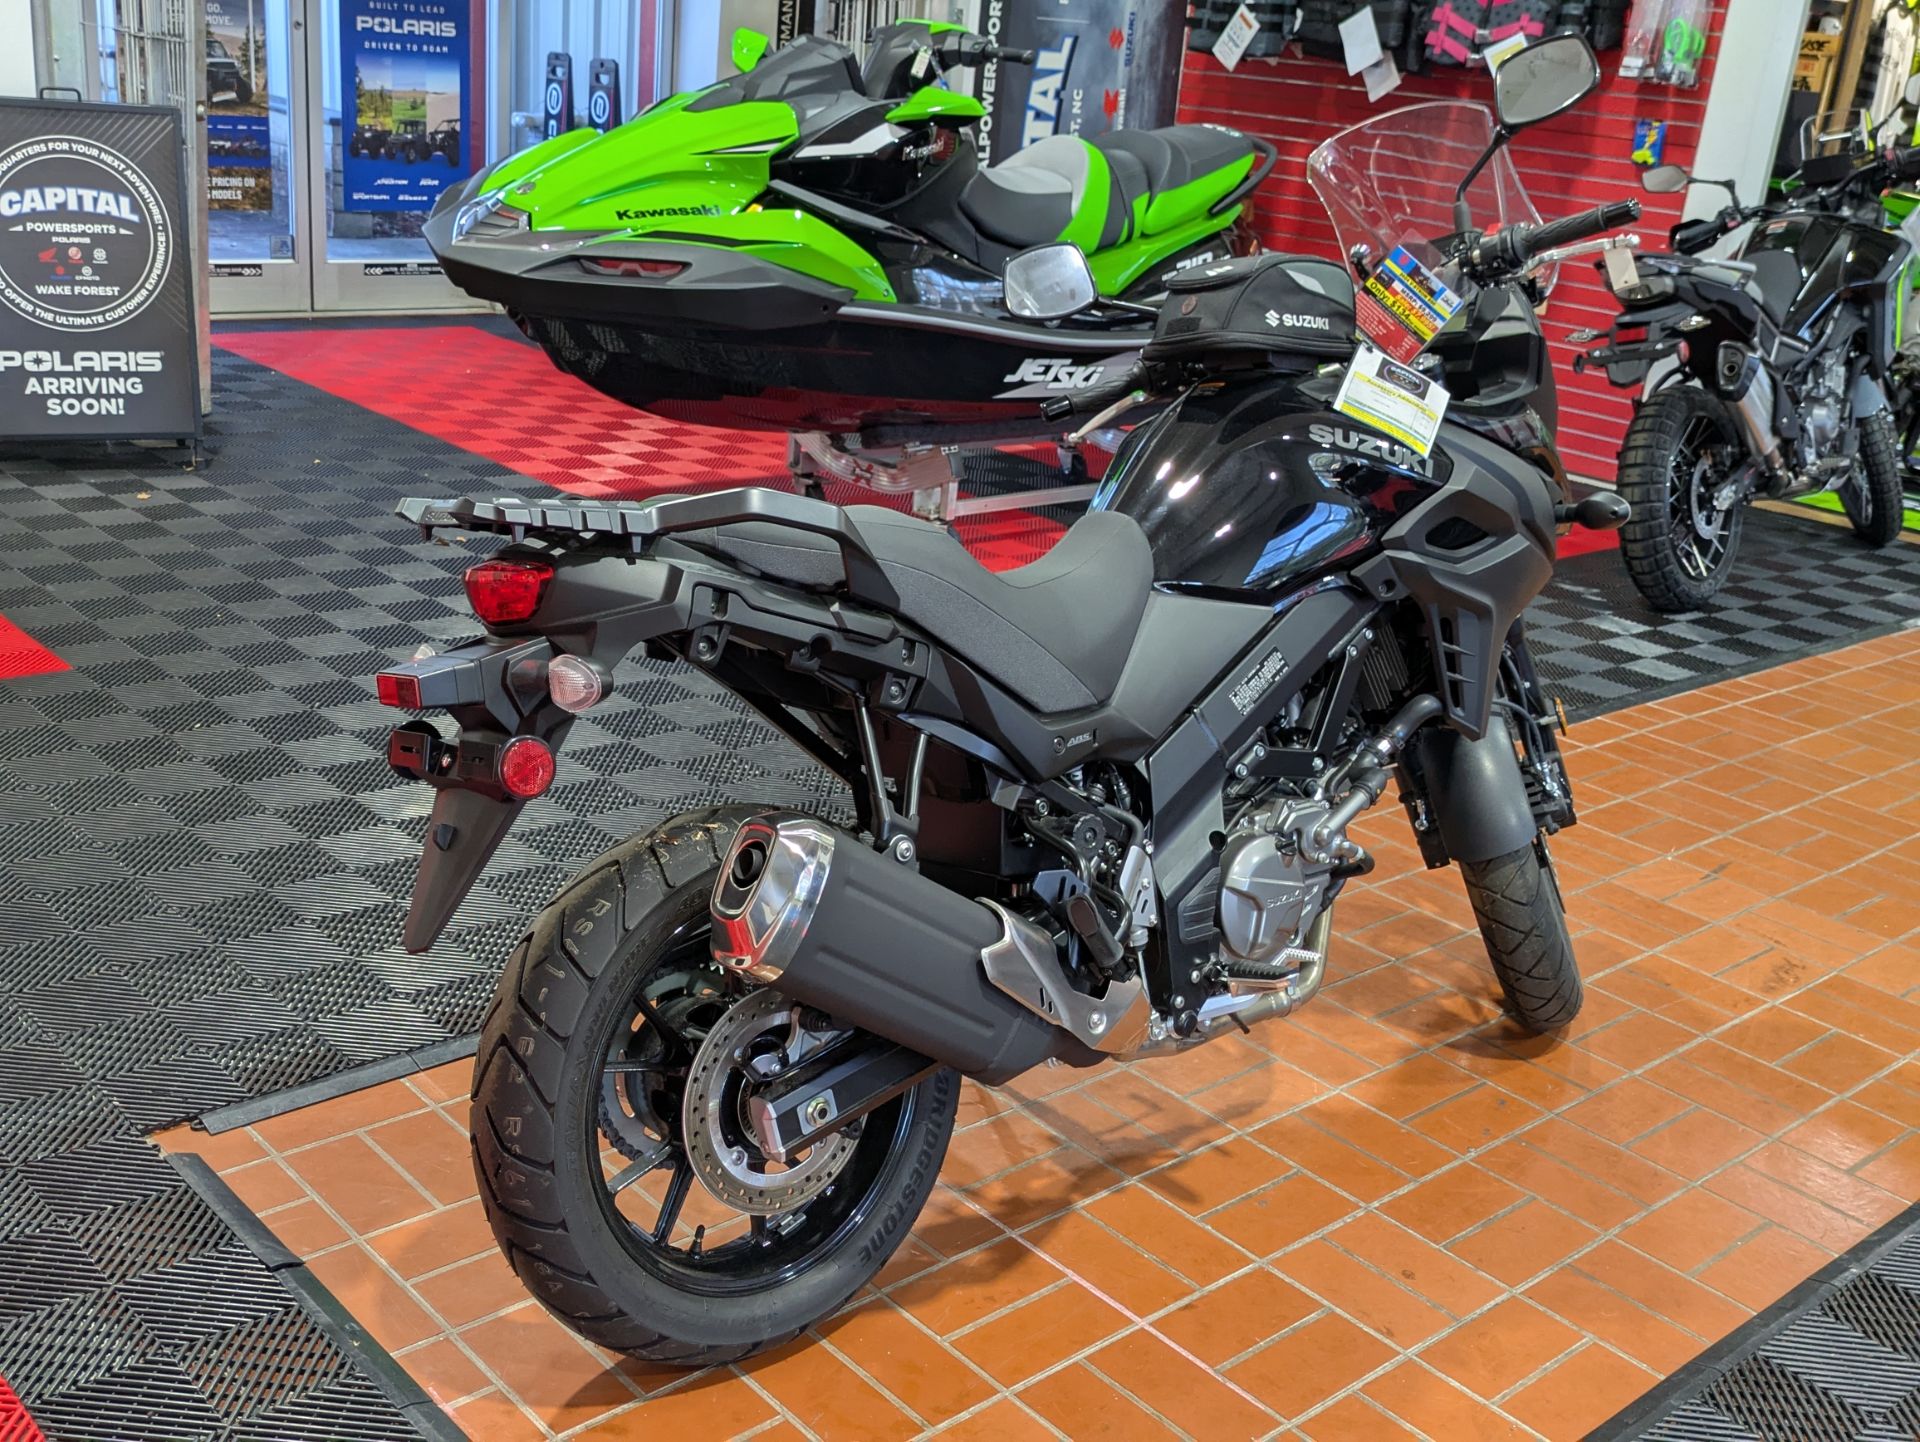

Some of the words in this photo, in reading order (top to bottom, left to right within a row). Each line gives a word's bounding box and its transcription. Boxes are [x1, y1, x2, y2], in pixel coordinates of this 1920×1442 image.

[369, 1, 398, 10] BUILT
[403, 4, 415, 12] TO
[420, 5, 445, 14] LEAD
[356, 15, 456, 37] POLARIS
[364, 41, 401, 51] DRIVEN
[406, 43, 418, 52] TO
[422, 45, 448, 53] ROAM
[1125, 11, 1136, 68] SUZUKI
[1073, 89, 1083, 114] NC
[0, 143, 47, 176] QUARTERS
[48, 141, 70, 151] FOR
[71, 142, 100, 158] YOUR
[99, 151, 126, 171] NEXT
[123, 169, 164, 225] ADVENTURE!
[212, 177, 242, 187] PRICING
[244, 177, 256, 187] ON
[212, 190, 242, 200] MODELS
[0, 186, 140, 223] CAPITAL
[616, 204, 721, 221] Kawasaki
[27, 222, 117, 234] POWERSPORTS
[5, 287, 34, 313] OFFER
[35, 307, 55, 321] THE
[56, 314, 105, 326] ULTIMATE
[105, 288, 149, 321] CUSTOMER
[145, 231, 166, 291] EXPERIENCE!
[35, 285, 72, 295] WAKE
[74, 286, 120, 296] FOREST
[1389, 299, 1411, 320] $134
[1283, 314, 1329, 330] SUZUKI
[0, 350, 163, 372] POLARIS
[25, 377, 143, 395] ARRIVING
[47, 398, 125, 415] SOON!
[1309, 423, 1433, 478] SUZUKI
